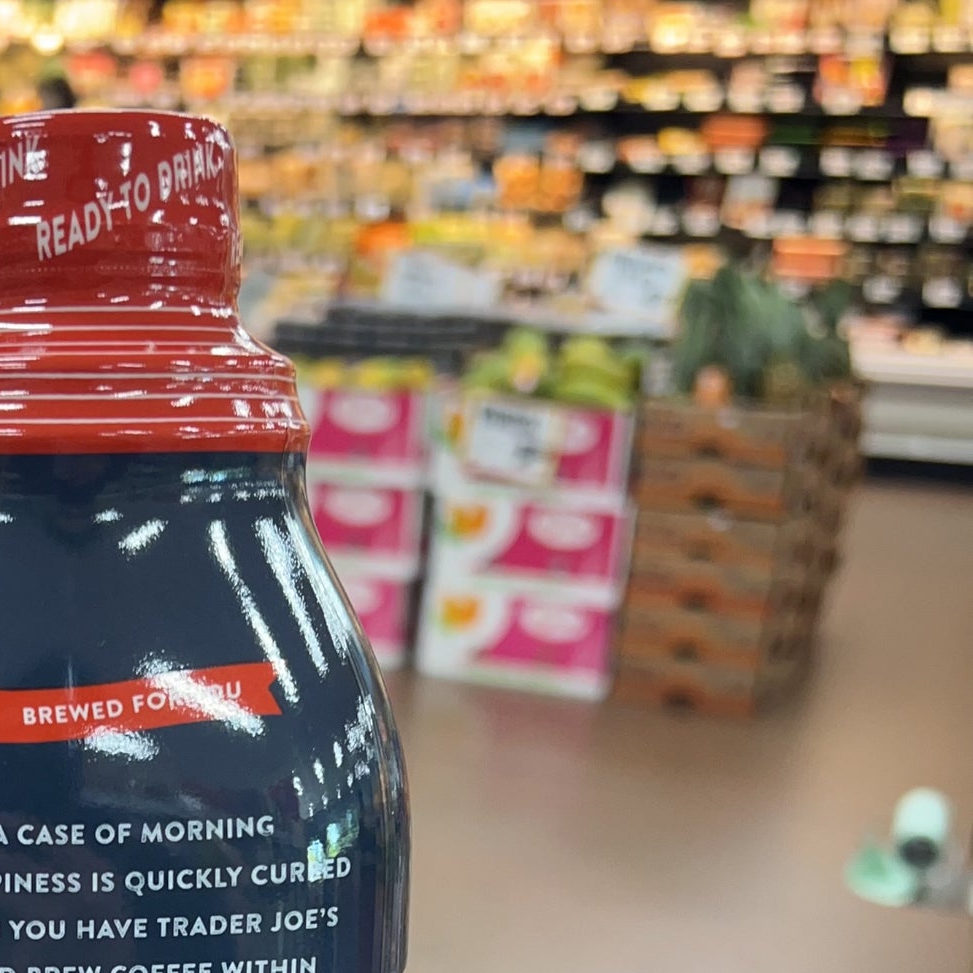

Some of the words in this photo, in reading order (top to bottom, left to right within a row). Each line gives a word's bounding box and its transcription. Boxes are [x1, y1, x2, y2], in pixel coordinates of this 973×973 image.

[36, 191, 114, 261] READY
[119, 172, 150, 219] TO
[22, 700, 123, 726] BREWED
[17, 824, 85, 845] CASE
[95, 824, 131, 844] OF
[141, 815, 274, 843] MORNING
[92, 872, 115, 892] IS
[124, 866, 243, 896] QUICKLY
[8, 920, 66, 940] YOU
[77, 918, 148, 939] HAVE
[157, 913, 262, 937] TRADER
[270, 906, 339, 932] JOE'S
